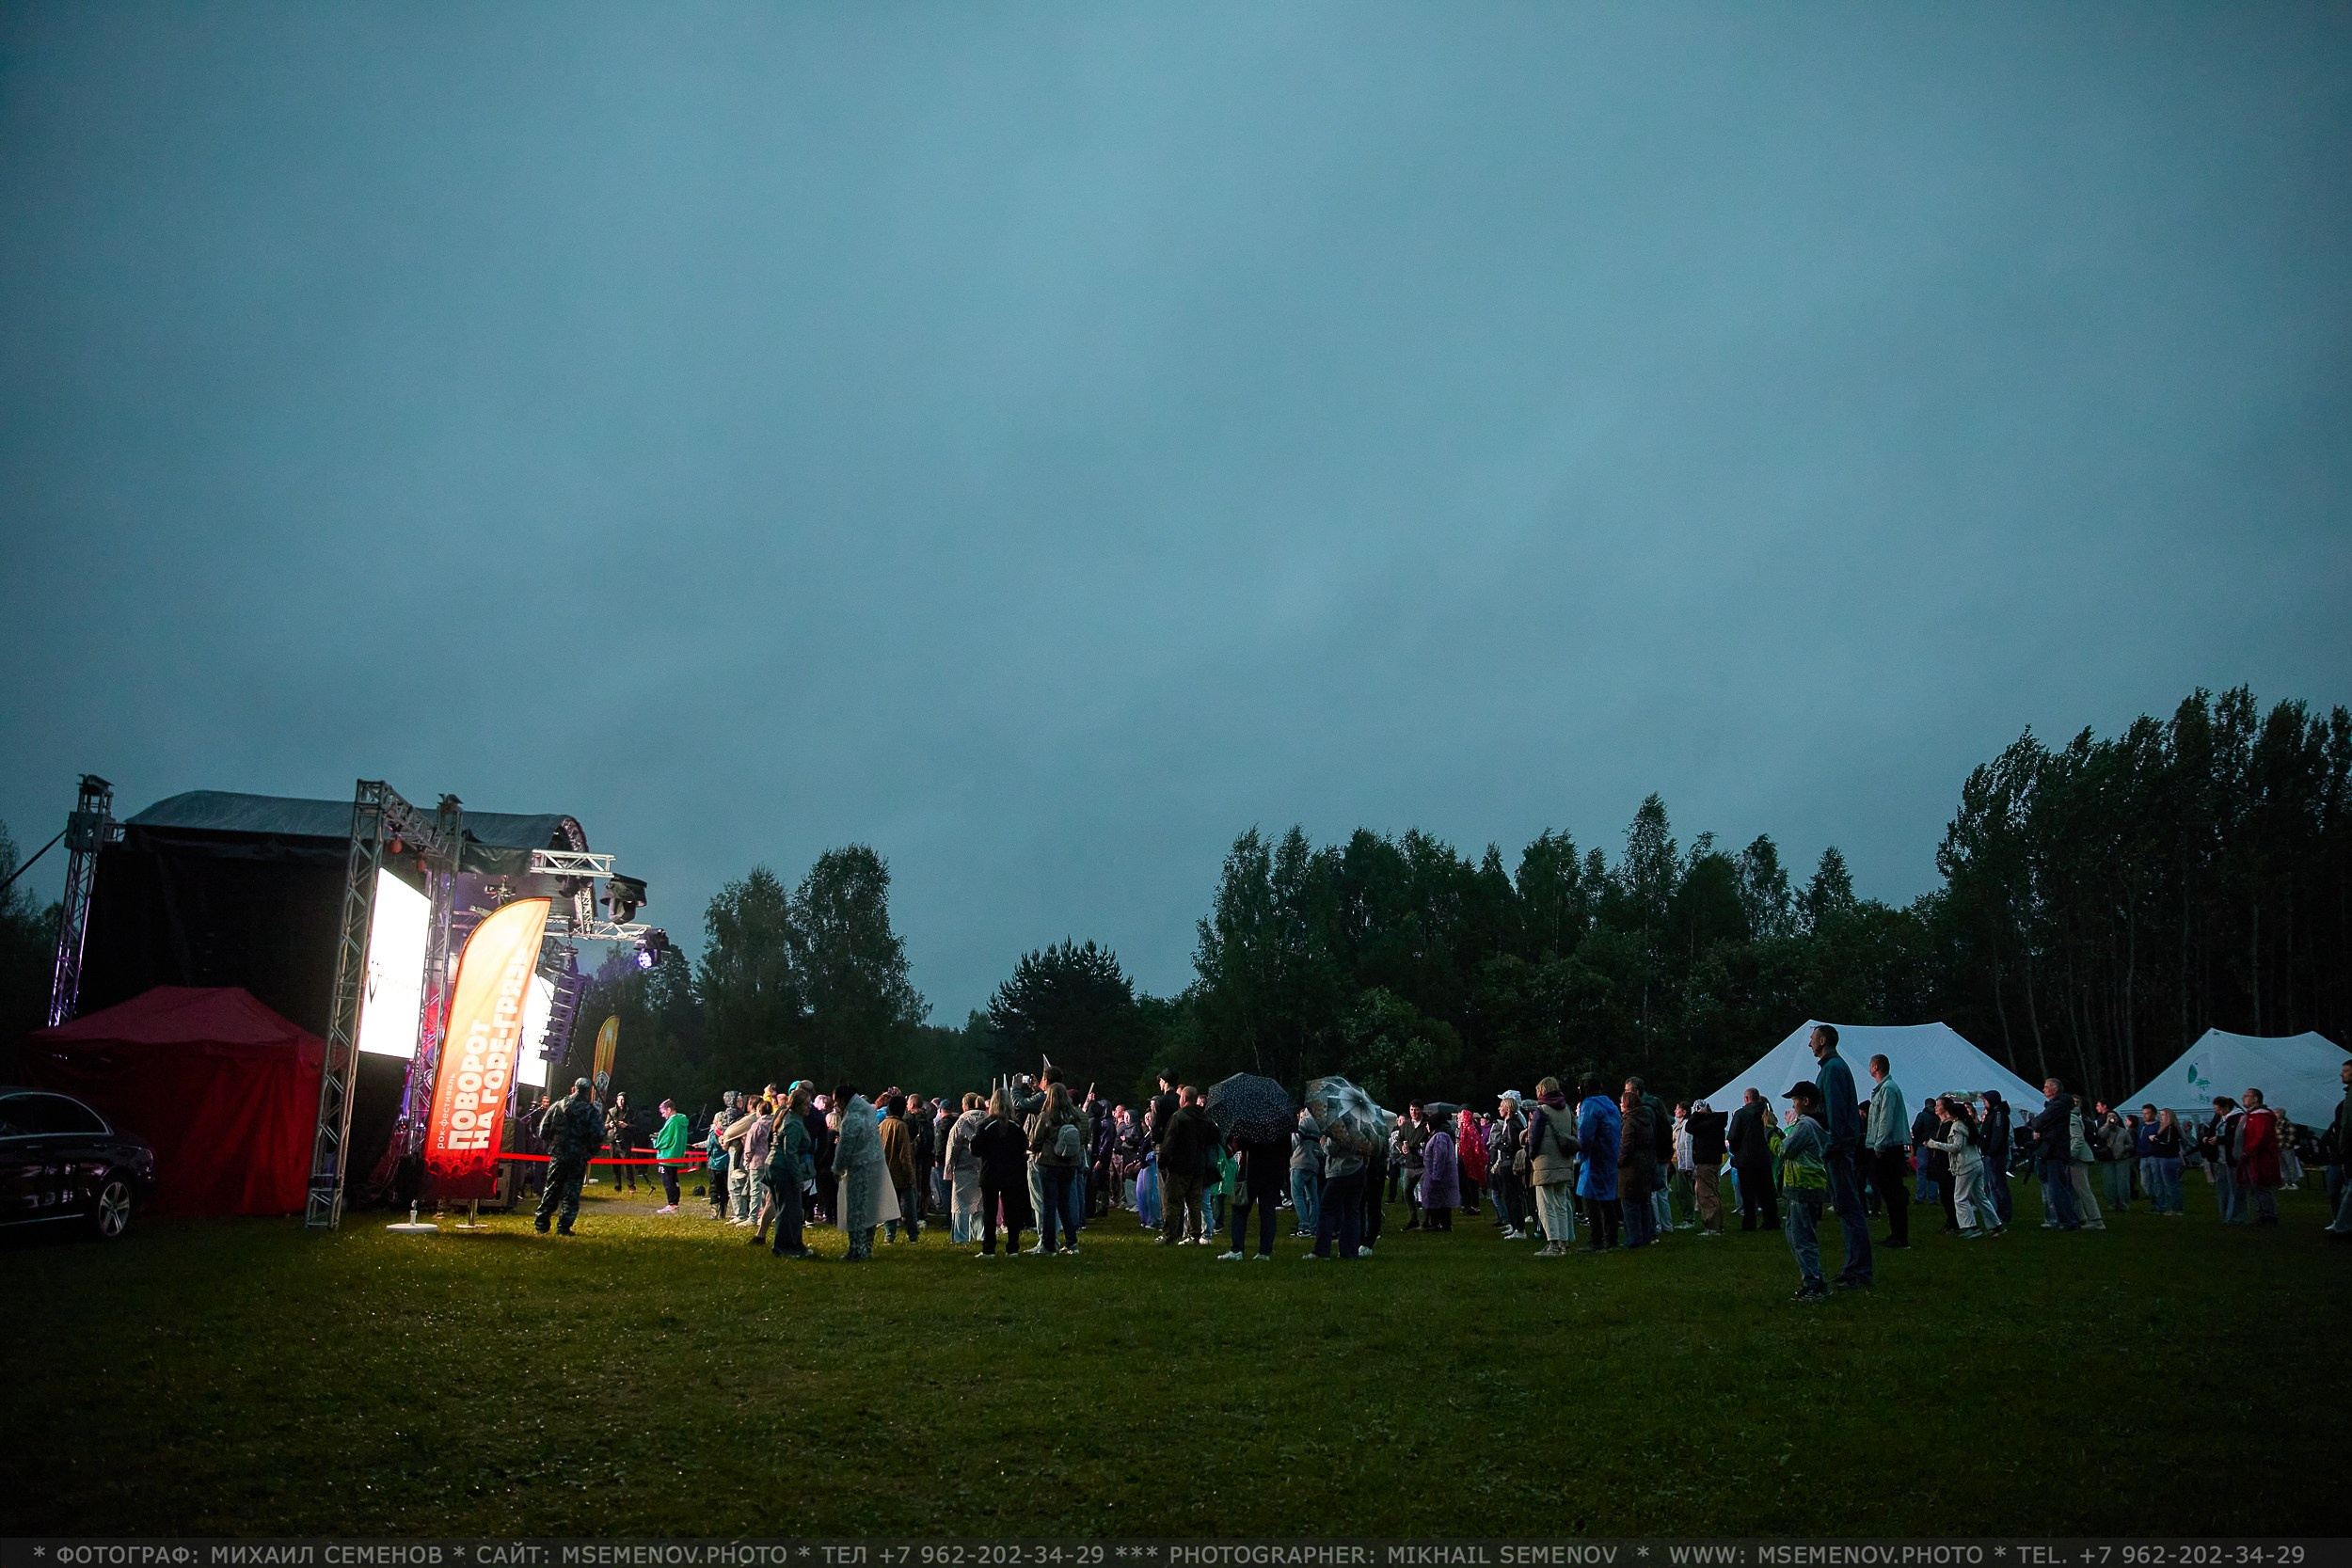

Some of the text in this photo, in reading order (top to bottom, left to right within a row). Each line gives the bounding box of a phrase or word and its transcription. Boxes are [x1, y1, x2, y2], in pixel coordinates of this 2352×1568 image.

[437, 1072, 456, 1150] рок-фестиваль
[447, 1018, 491, 1150] ПОВОРОТ
[471, 1110, 495, 1149] НА
